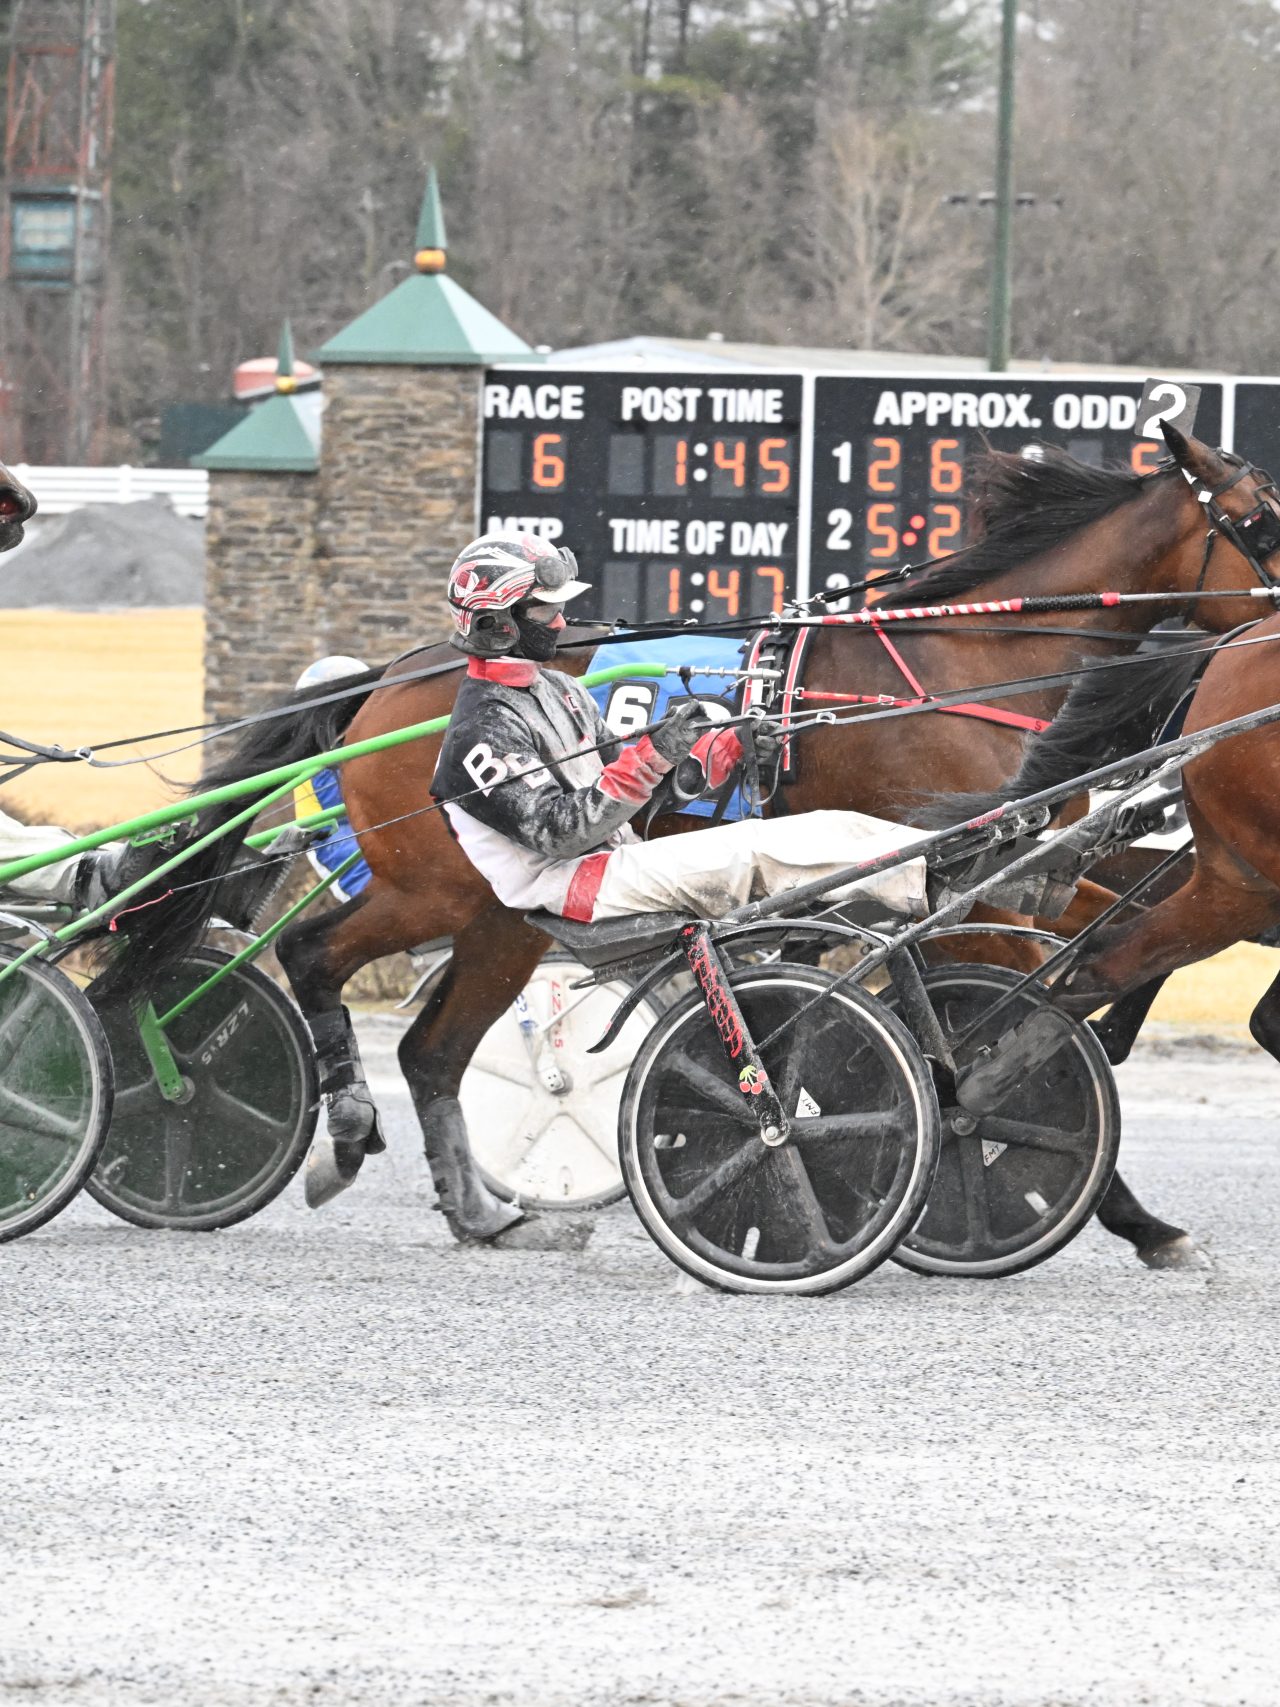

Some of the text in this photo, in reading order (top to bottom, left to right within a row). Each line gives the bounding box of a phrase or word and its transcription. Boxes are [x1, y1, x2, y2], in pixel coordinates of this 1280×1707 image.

[484, 384, 585, 420] RACE
[621, 386, 784, 424] POST TIME
[873, 391, 1141, 430] APPROX. ODD
[1142, 383, 1187, 439] 2
[532, 433, 566, 488] 6
[675, 438, 790, 493] 1:45
[831, 441, 853, 483] 1
[608, 519, 788, 557] TIME OF DAY
[826, 508, 853, 551] 2
[667, 567, 785, 618] 1:47
[604, 685, 653, 737] 6
